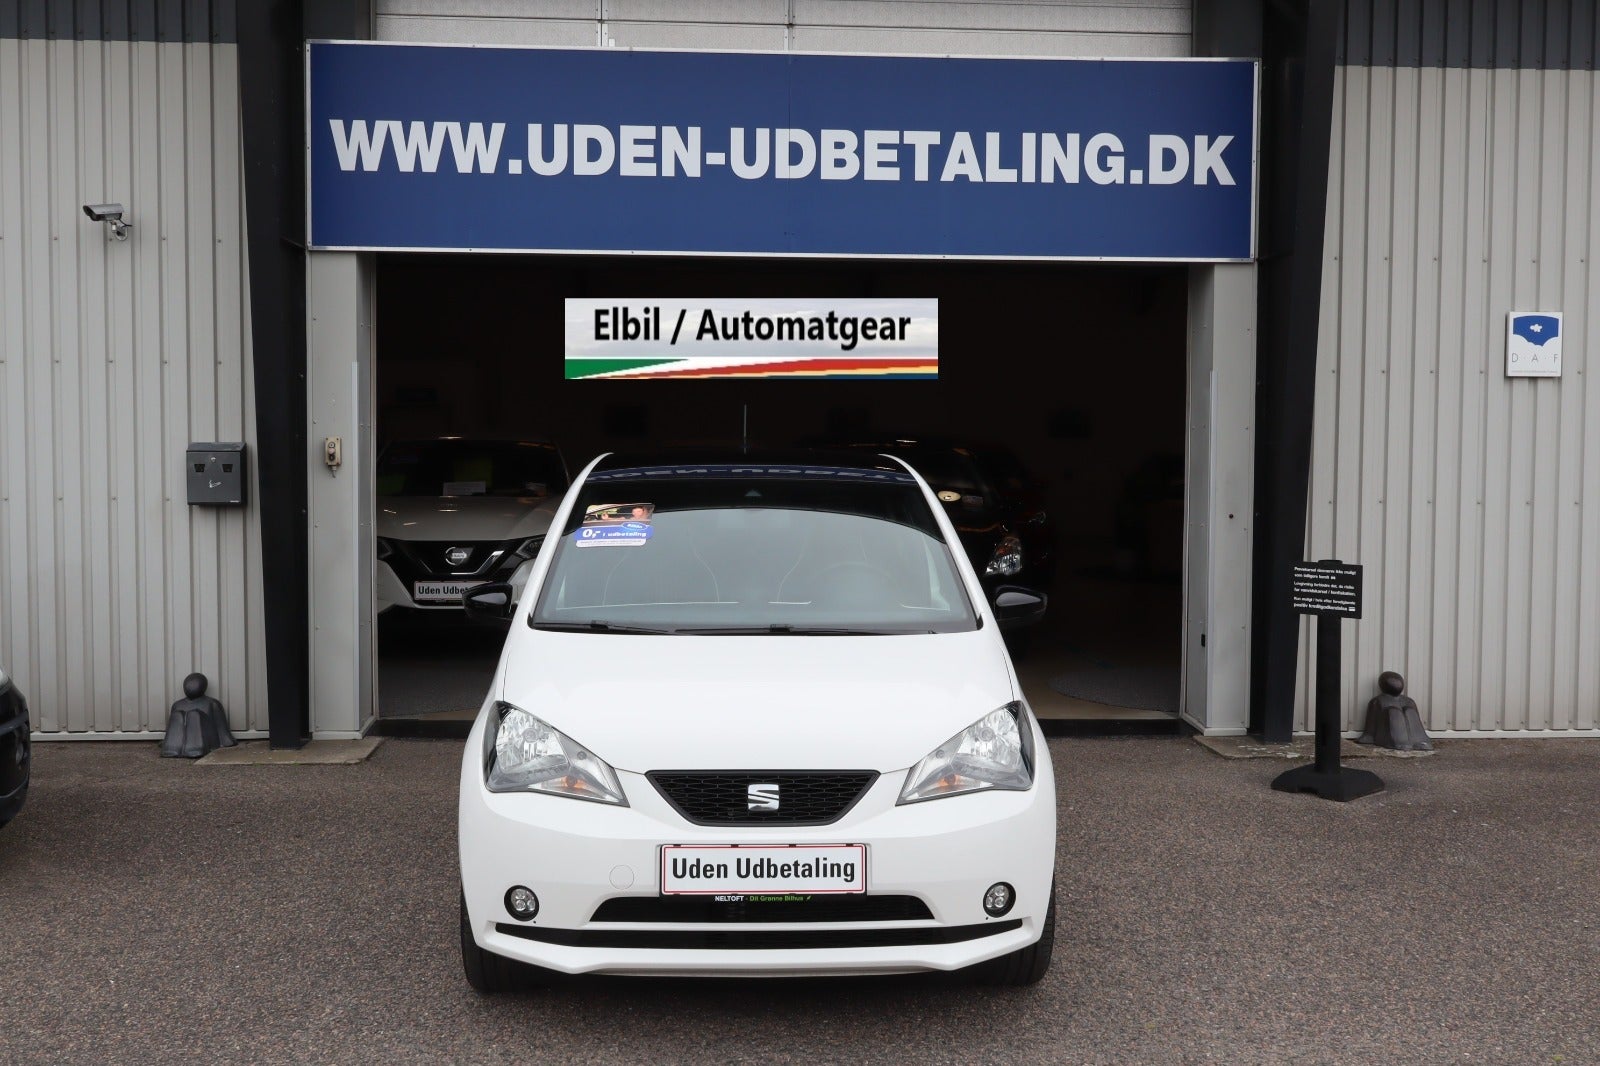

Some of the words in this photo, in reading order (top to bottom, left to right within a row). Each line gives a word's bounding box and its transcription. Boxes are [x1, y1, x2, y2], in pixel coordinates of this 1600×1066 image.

[330, 120, 1234, 185] WWW.UDEN-UDBETALING.DK
[418, 585, 440, 595] Uden
[672, 857, 729, 879] Uden
[736, 857, 855, 883] Udbetaling
[714, 894, 745, 902] NELTOFT
